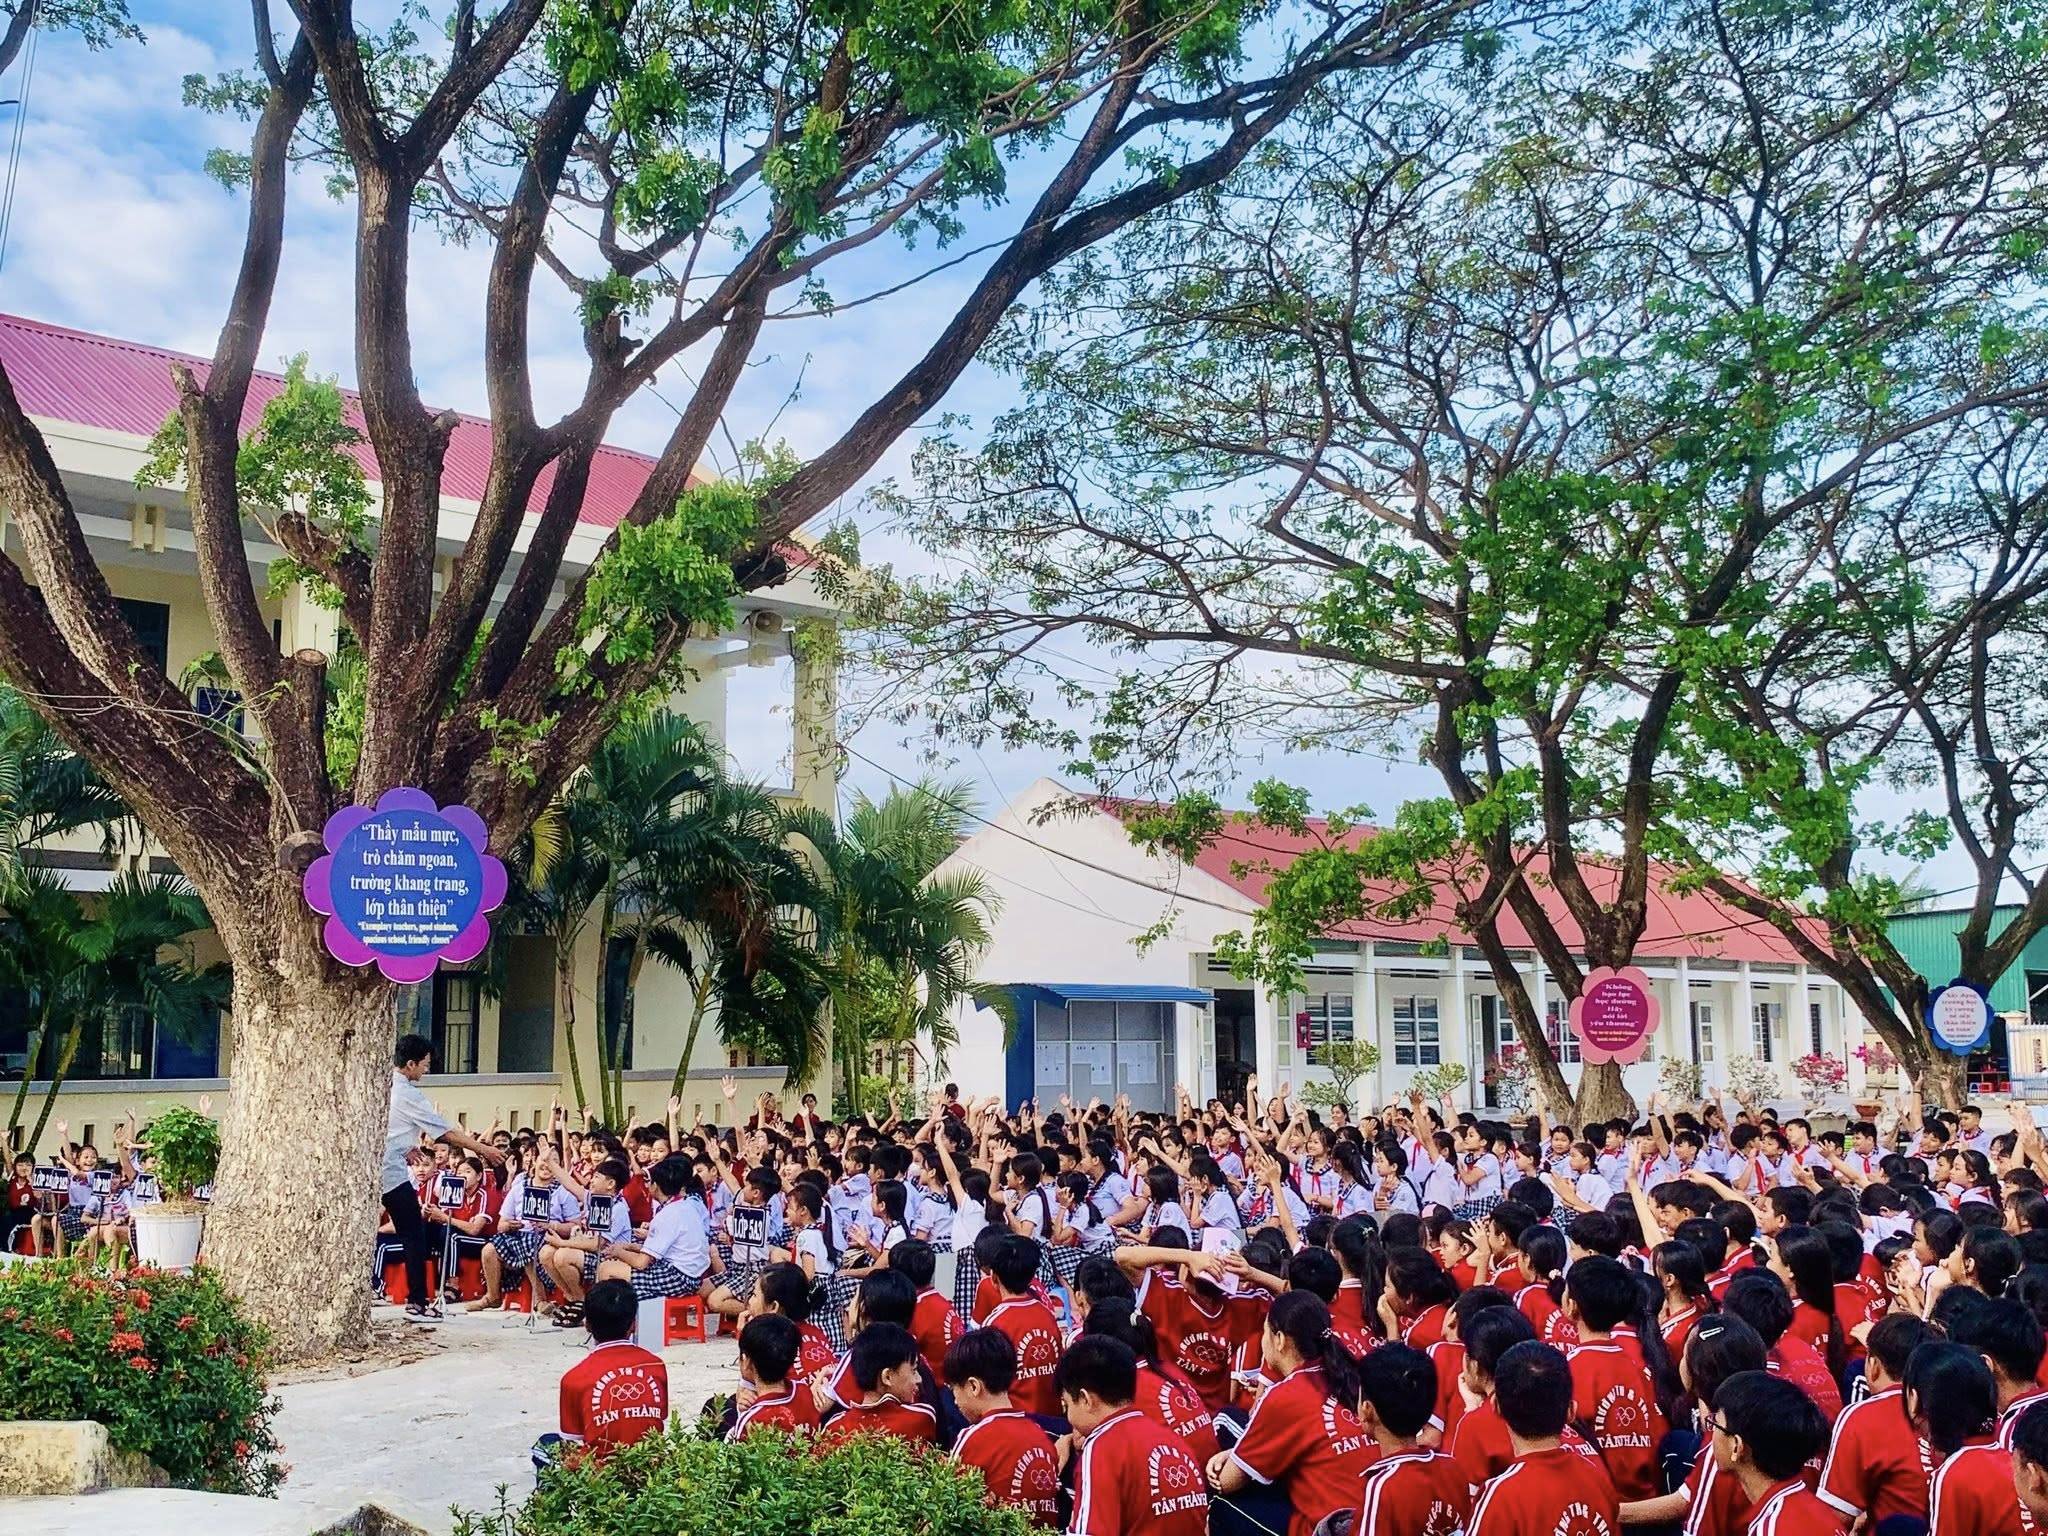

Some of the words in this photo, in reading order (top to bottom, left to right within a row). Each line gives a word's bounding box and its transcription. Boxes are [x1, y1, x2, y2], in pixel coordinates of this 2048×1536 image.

[361, 819, 398, 846] “Thầy
[402, 821, 427, 842] mẫu
[430, 829, 460, 848] mực,
[363, 848, 381, 866] trò
[384, 849, 416, 866] chăm
[419, 853, 458, 871] ngoan,
[350, 873, 392, 895] trường
[395, 874, 431, 896] khang
[434, 876, 470, 897] trang,
[365, 898, 385, 921] lớp
[388, 898, 415, 916] thân
[418, 898, 455, 921] thiện”
[524, 1192, 536, 1214] LỚP
[735, 1212, 749, 1239] LỚP
[749, 1219, 763, 1240] 5A3
[593, 1409, 620, 1427] TÂN
[622, 1403, 661, 1420] THÀNH
[1331, 1435, 1361, 1455] TÂN
[1152, 1497, 1177, 1516] TÂN
